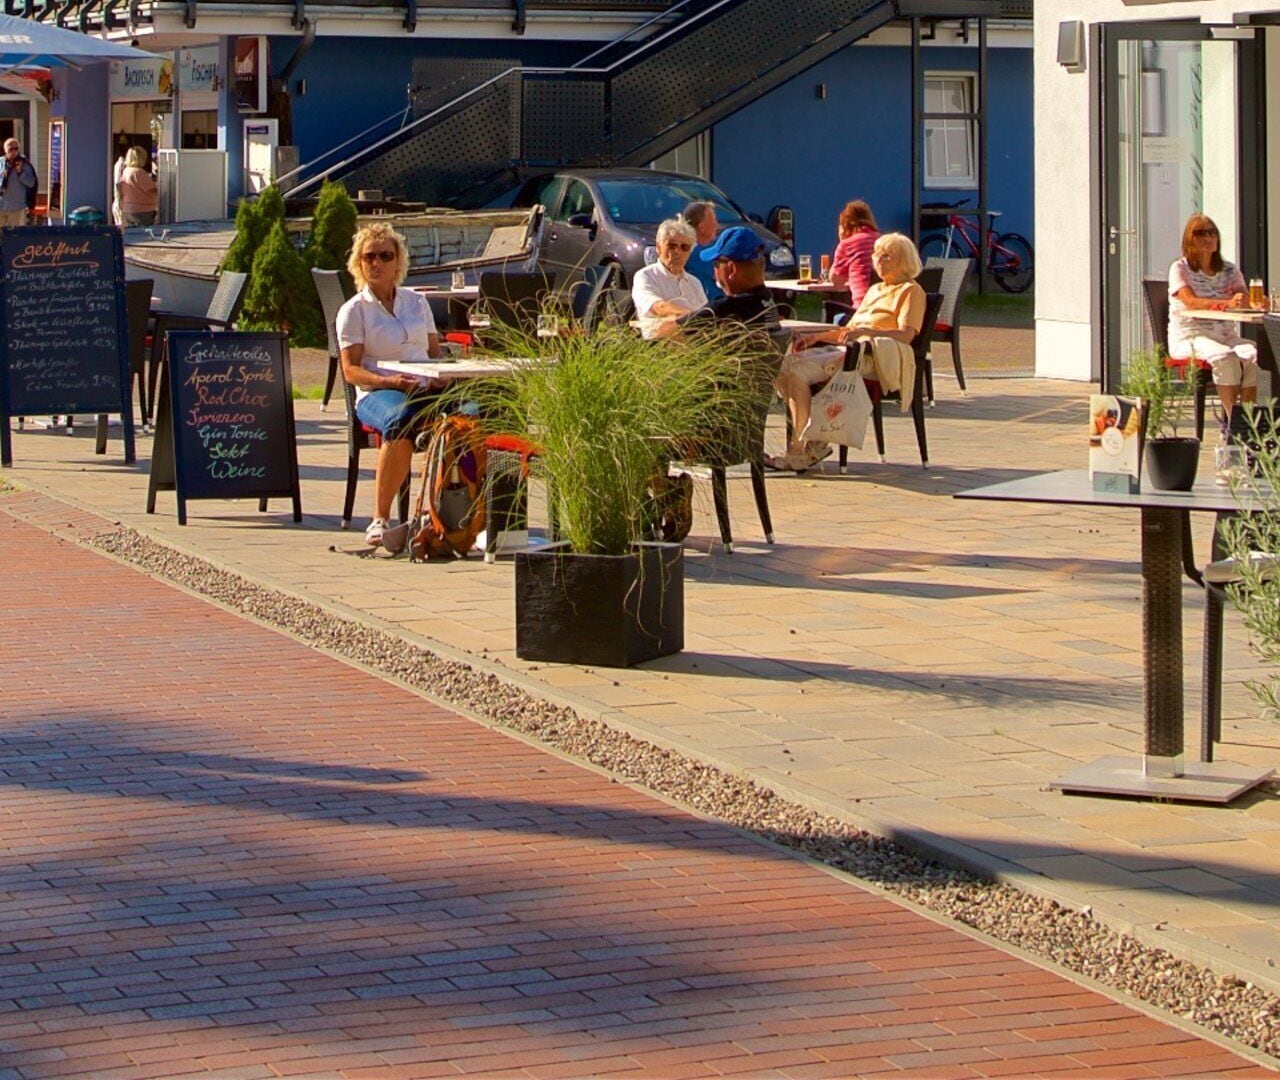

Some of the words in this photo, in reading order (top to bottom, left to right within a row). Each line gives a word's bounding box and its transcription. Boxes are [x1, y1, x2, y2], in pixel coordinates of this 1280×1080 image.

[184, 365, 233, 389] Aperol
[209, 440, 251, 460] Sekt
[205, 459, 267, 480] Weine
